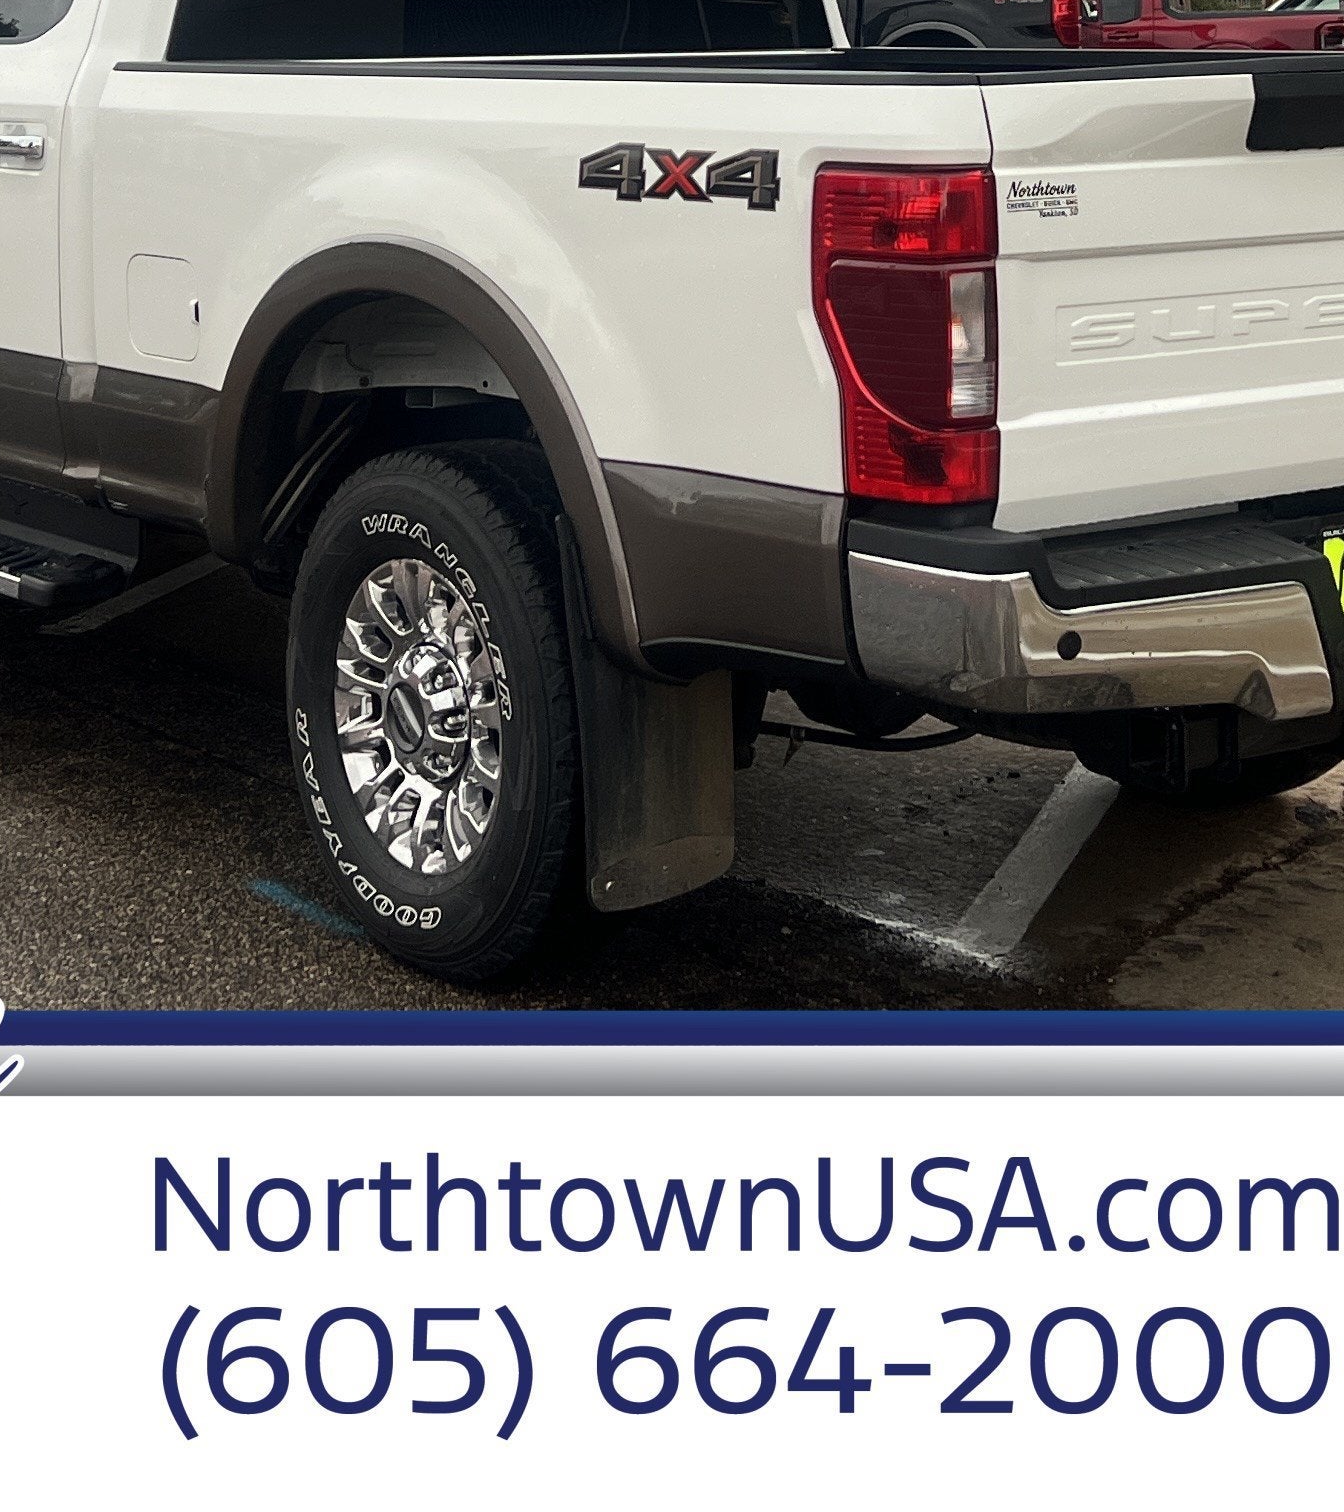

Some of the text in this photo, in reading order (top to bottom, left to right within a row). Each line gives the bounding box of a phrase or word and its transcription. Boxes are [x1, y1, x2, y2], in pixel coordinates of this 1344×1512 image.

[1006, 180, 1078, 199] Northtown
[360, 511, 513, 722] WRANGLER
[292, 707, 443, 930] GOODYEAR
